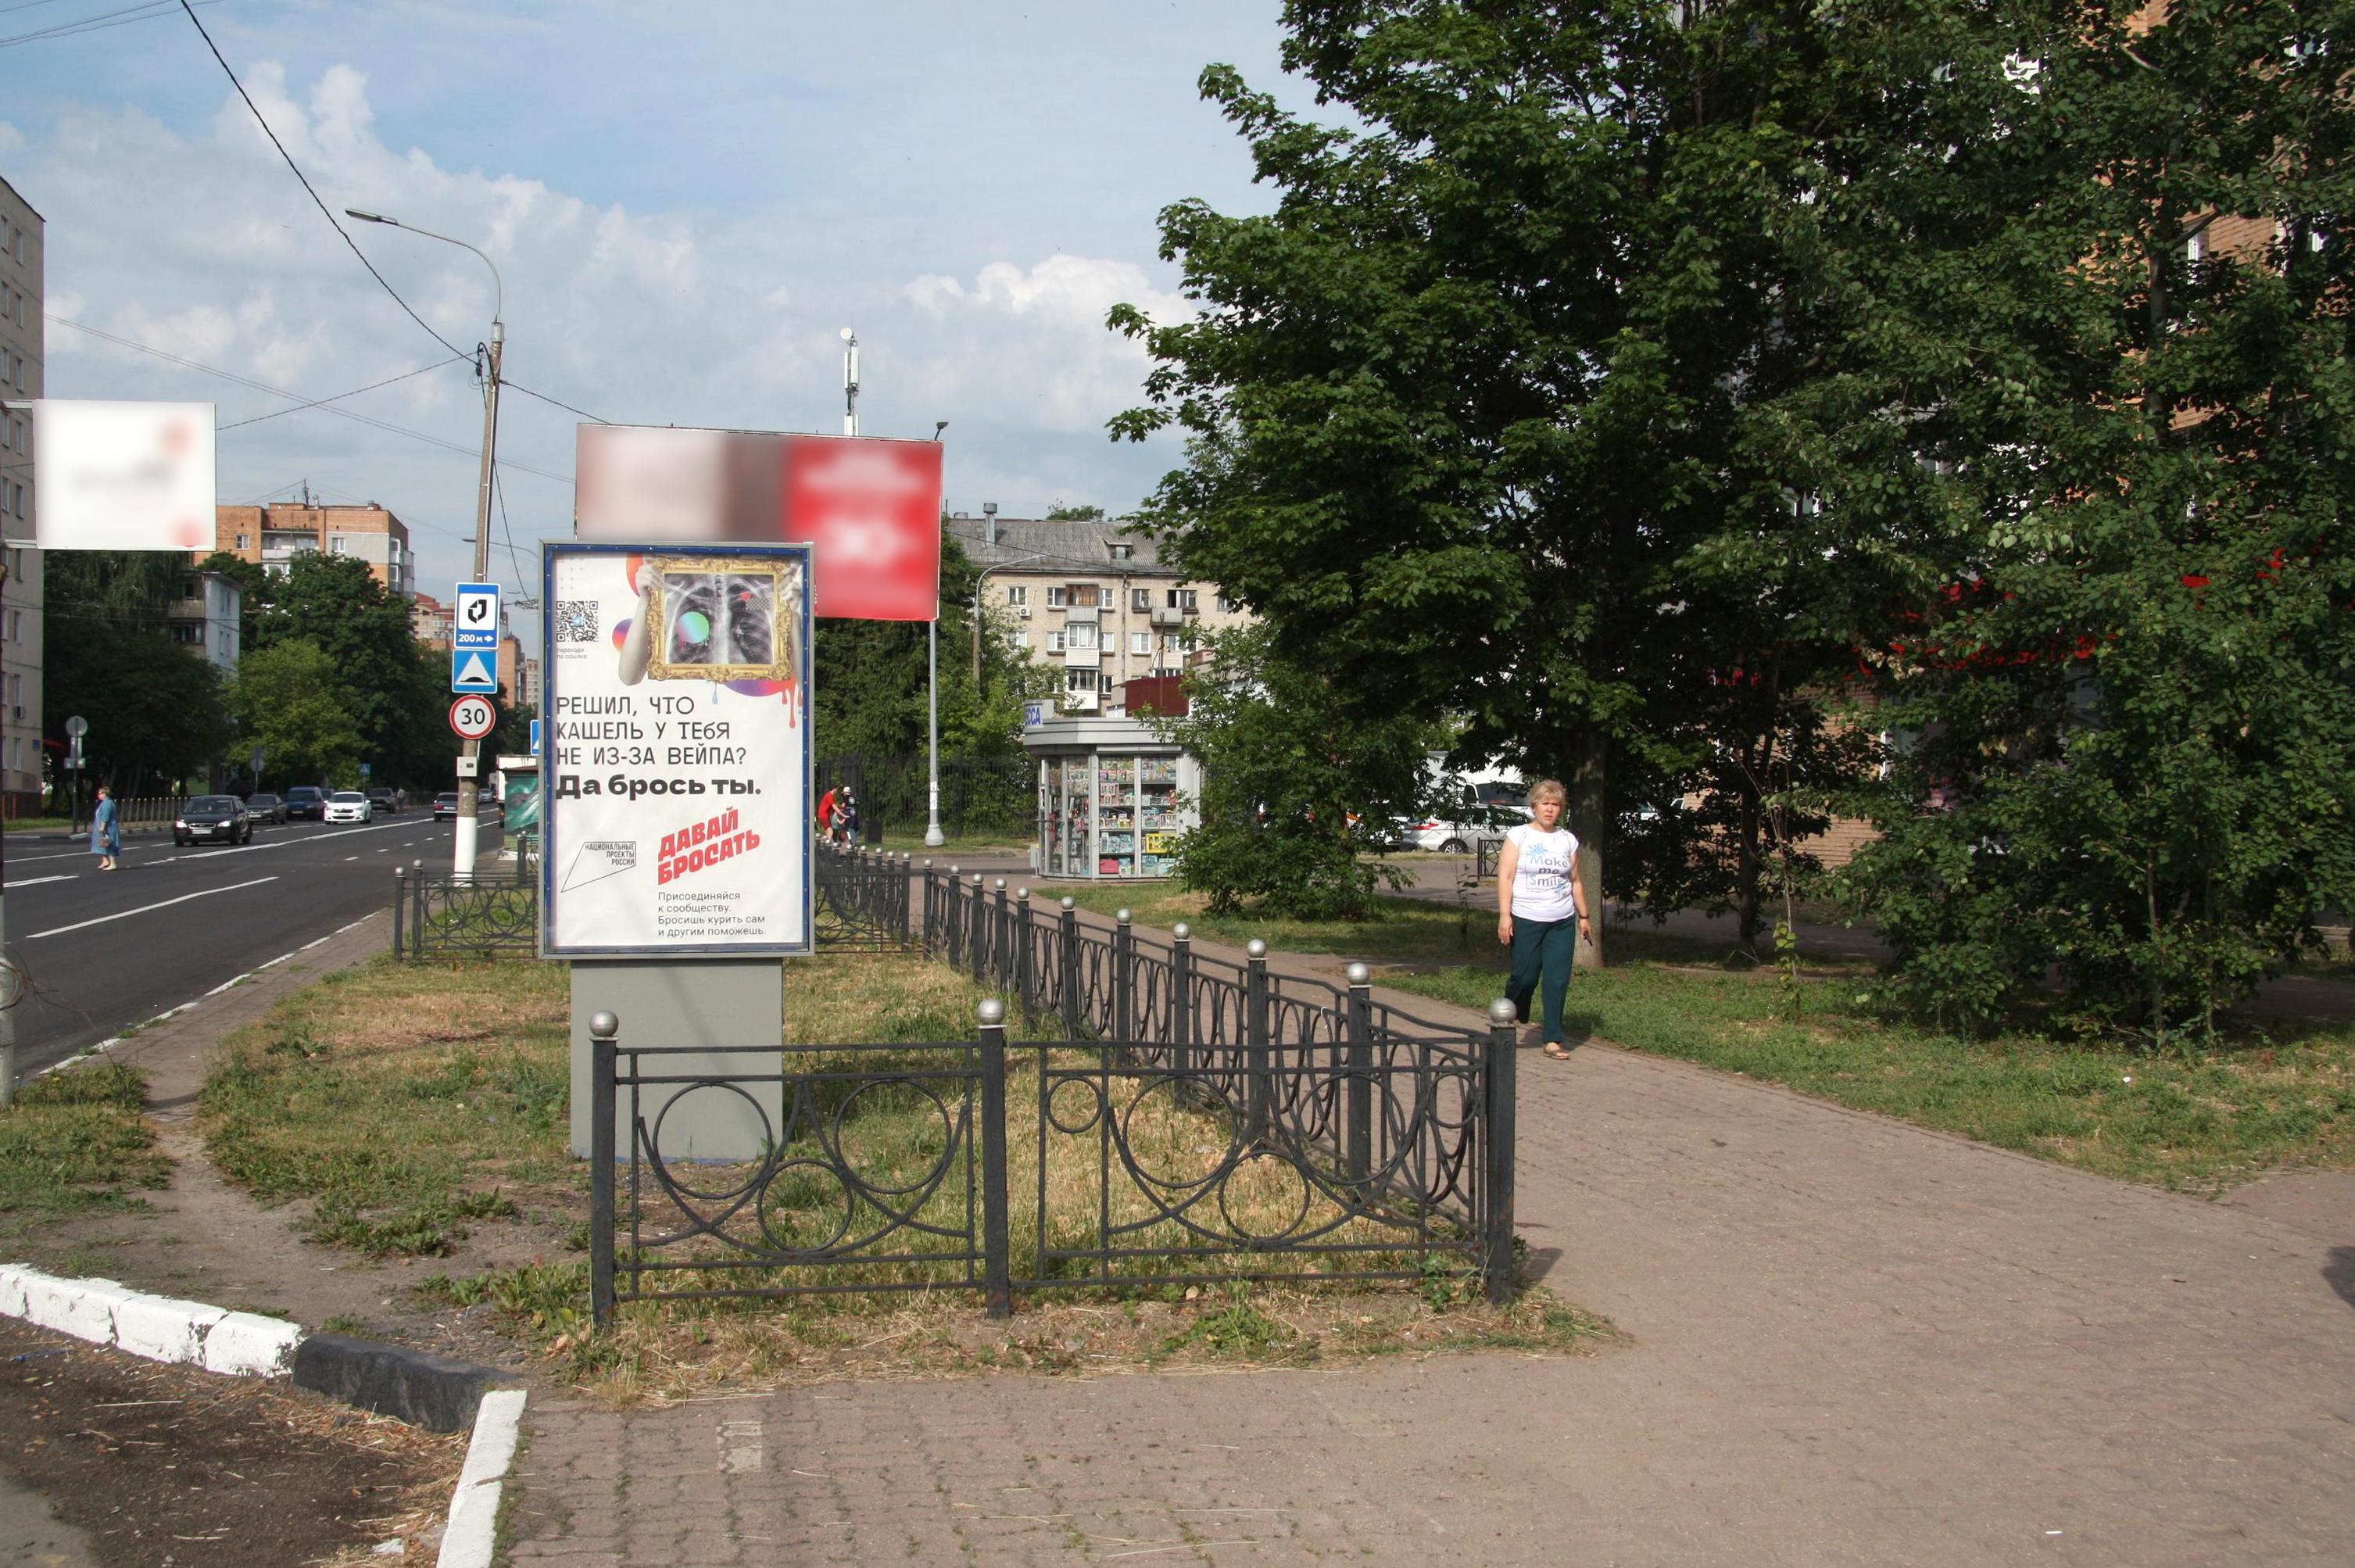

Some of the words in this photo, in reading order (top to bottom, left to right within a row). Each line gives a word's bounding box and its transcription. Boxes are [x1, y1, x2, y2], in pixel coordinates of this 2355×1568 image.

[458, 634, 475, 643] 200
[557, 696, 638, 716] РЕШИЛ,
[650, 696, 695, 714] ЧТО
[461, 708, 485, 725] 30
[557, 721, 643, 739] КАШЕЛЬ
[655, 721, 666, 739] У
[557, 747, 582, 764] НЕ
[593, 747, 656, 764] ИЗ-ЗА
[667, 743, 746, 764] ВЕЙПА?
[556, 775, 602, 799] Да
[608, 774, 706, 800] брось
[711, 779, 761, 795] ты.
[658, 806, 739, 862] ДАВАЙ
[585, 843, 635, 851] НАЦИОНАЛЬНЫЕ
[658, 829, 761, 886] БРОСАТЬ
[1530, 856, 1568, 868] Make
[1529, 875, 1563, 886] Smile
[658, 891, 740, 901] Присоединяйся
[667, 904, 732, 915] сообществу.
[658, 915, 705, 925] Бросишь
[707, 918, 743, 927] курить
[667, 928, 704, 940] другим
